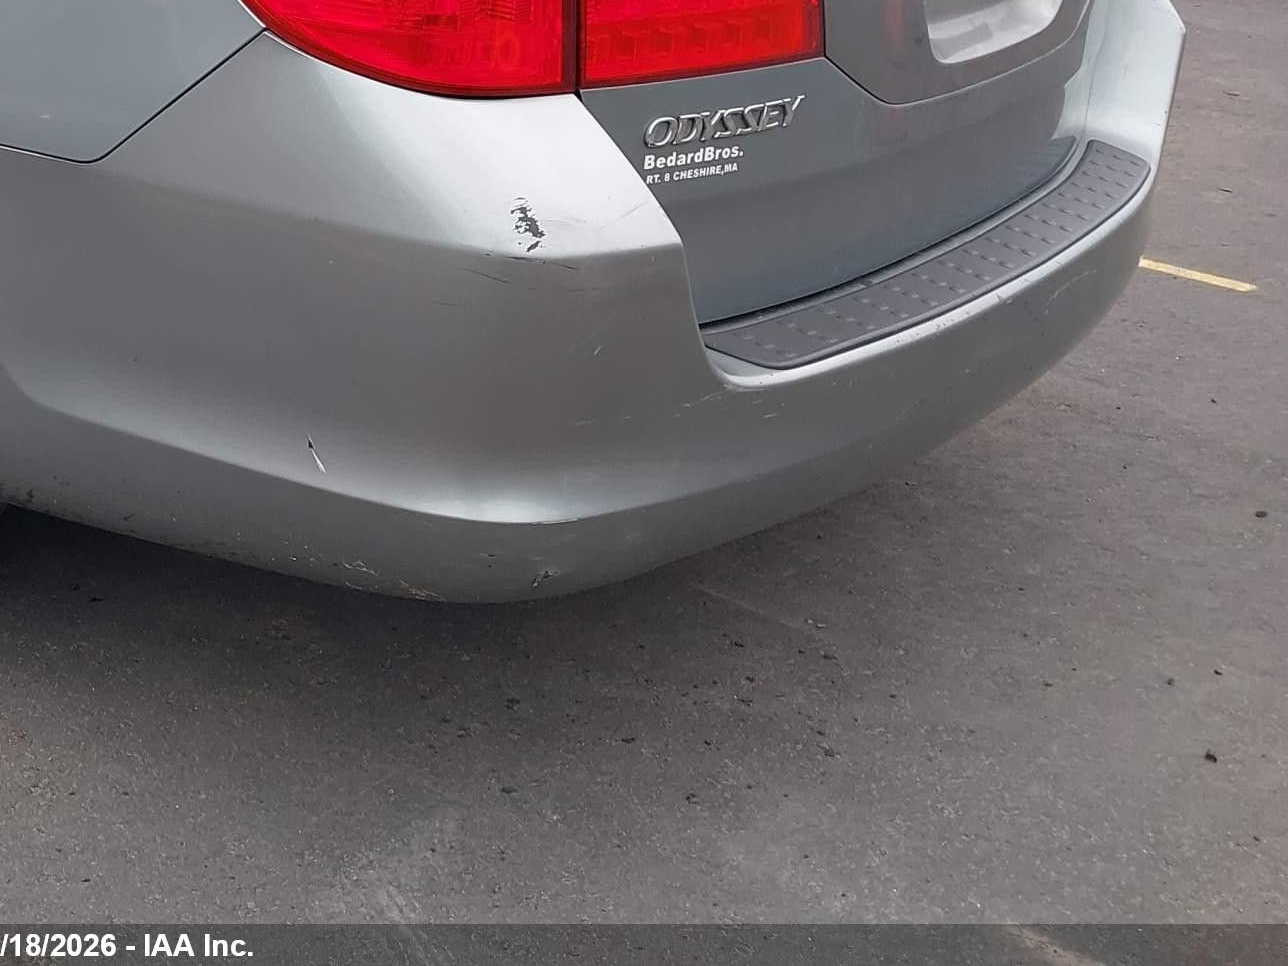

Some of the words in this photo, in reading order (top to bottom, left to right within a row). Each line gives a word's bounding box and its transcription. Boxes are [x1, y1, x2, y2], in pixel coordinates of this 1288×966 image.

[644, 94, 806, 148] ODYSSEY
[643, 145, 744, 170] BedardBros.
[646, 174, 662, 185] RT.
[664, 172, 671, 182] 8
